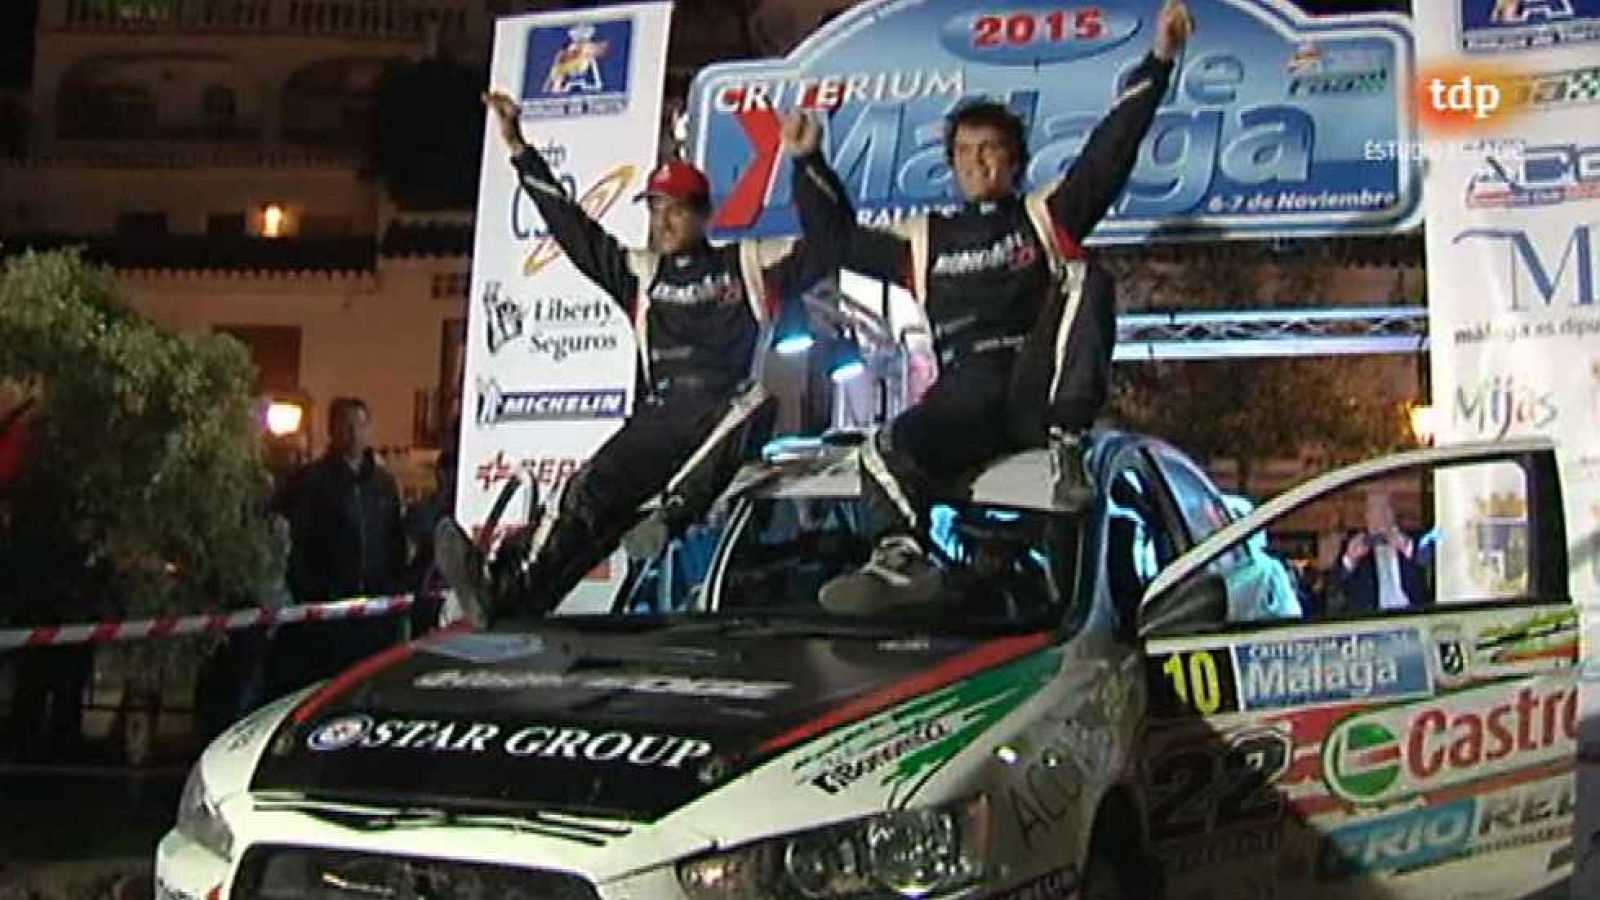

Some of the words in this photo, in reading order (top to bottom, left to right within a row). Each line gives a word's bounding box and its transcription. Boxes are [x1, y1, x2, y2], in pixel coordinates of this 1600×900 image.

[972, 8, 1104, 48] 2015
[714, 67, 966, 112] CRITERIUM
[1277, 187, 1396, 210] Noviembre
[534, 296, 613, 328] Liberty
[529, 333, 618, 362] Seguros
[502, 392, 626, 416] MICHELIN
[1451, 374, 1559, 443] Mijas
[1162, 650, 1222, 716] 10
[372, 720, 500, 751] STAR
[504, 726, 711, 768] GROUP
